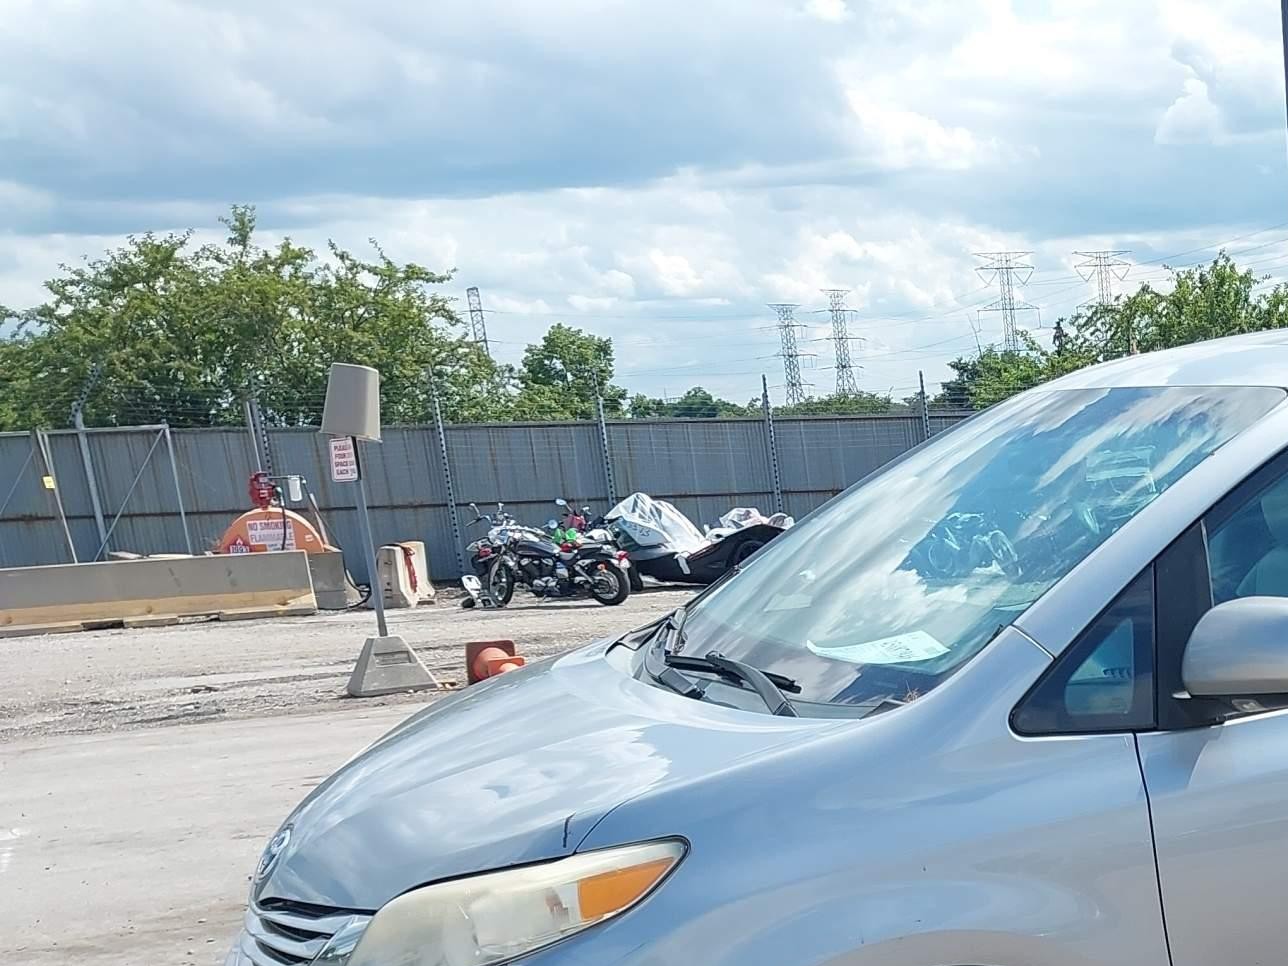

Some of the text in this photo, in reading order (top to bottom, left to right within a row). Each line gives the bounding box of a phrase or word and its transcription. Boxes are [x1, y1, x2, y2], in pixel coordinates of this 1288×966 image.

[247, 520, 292, 531] NO SMOKIG
[250, 532, 294, 543] FLAMMAE
